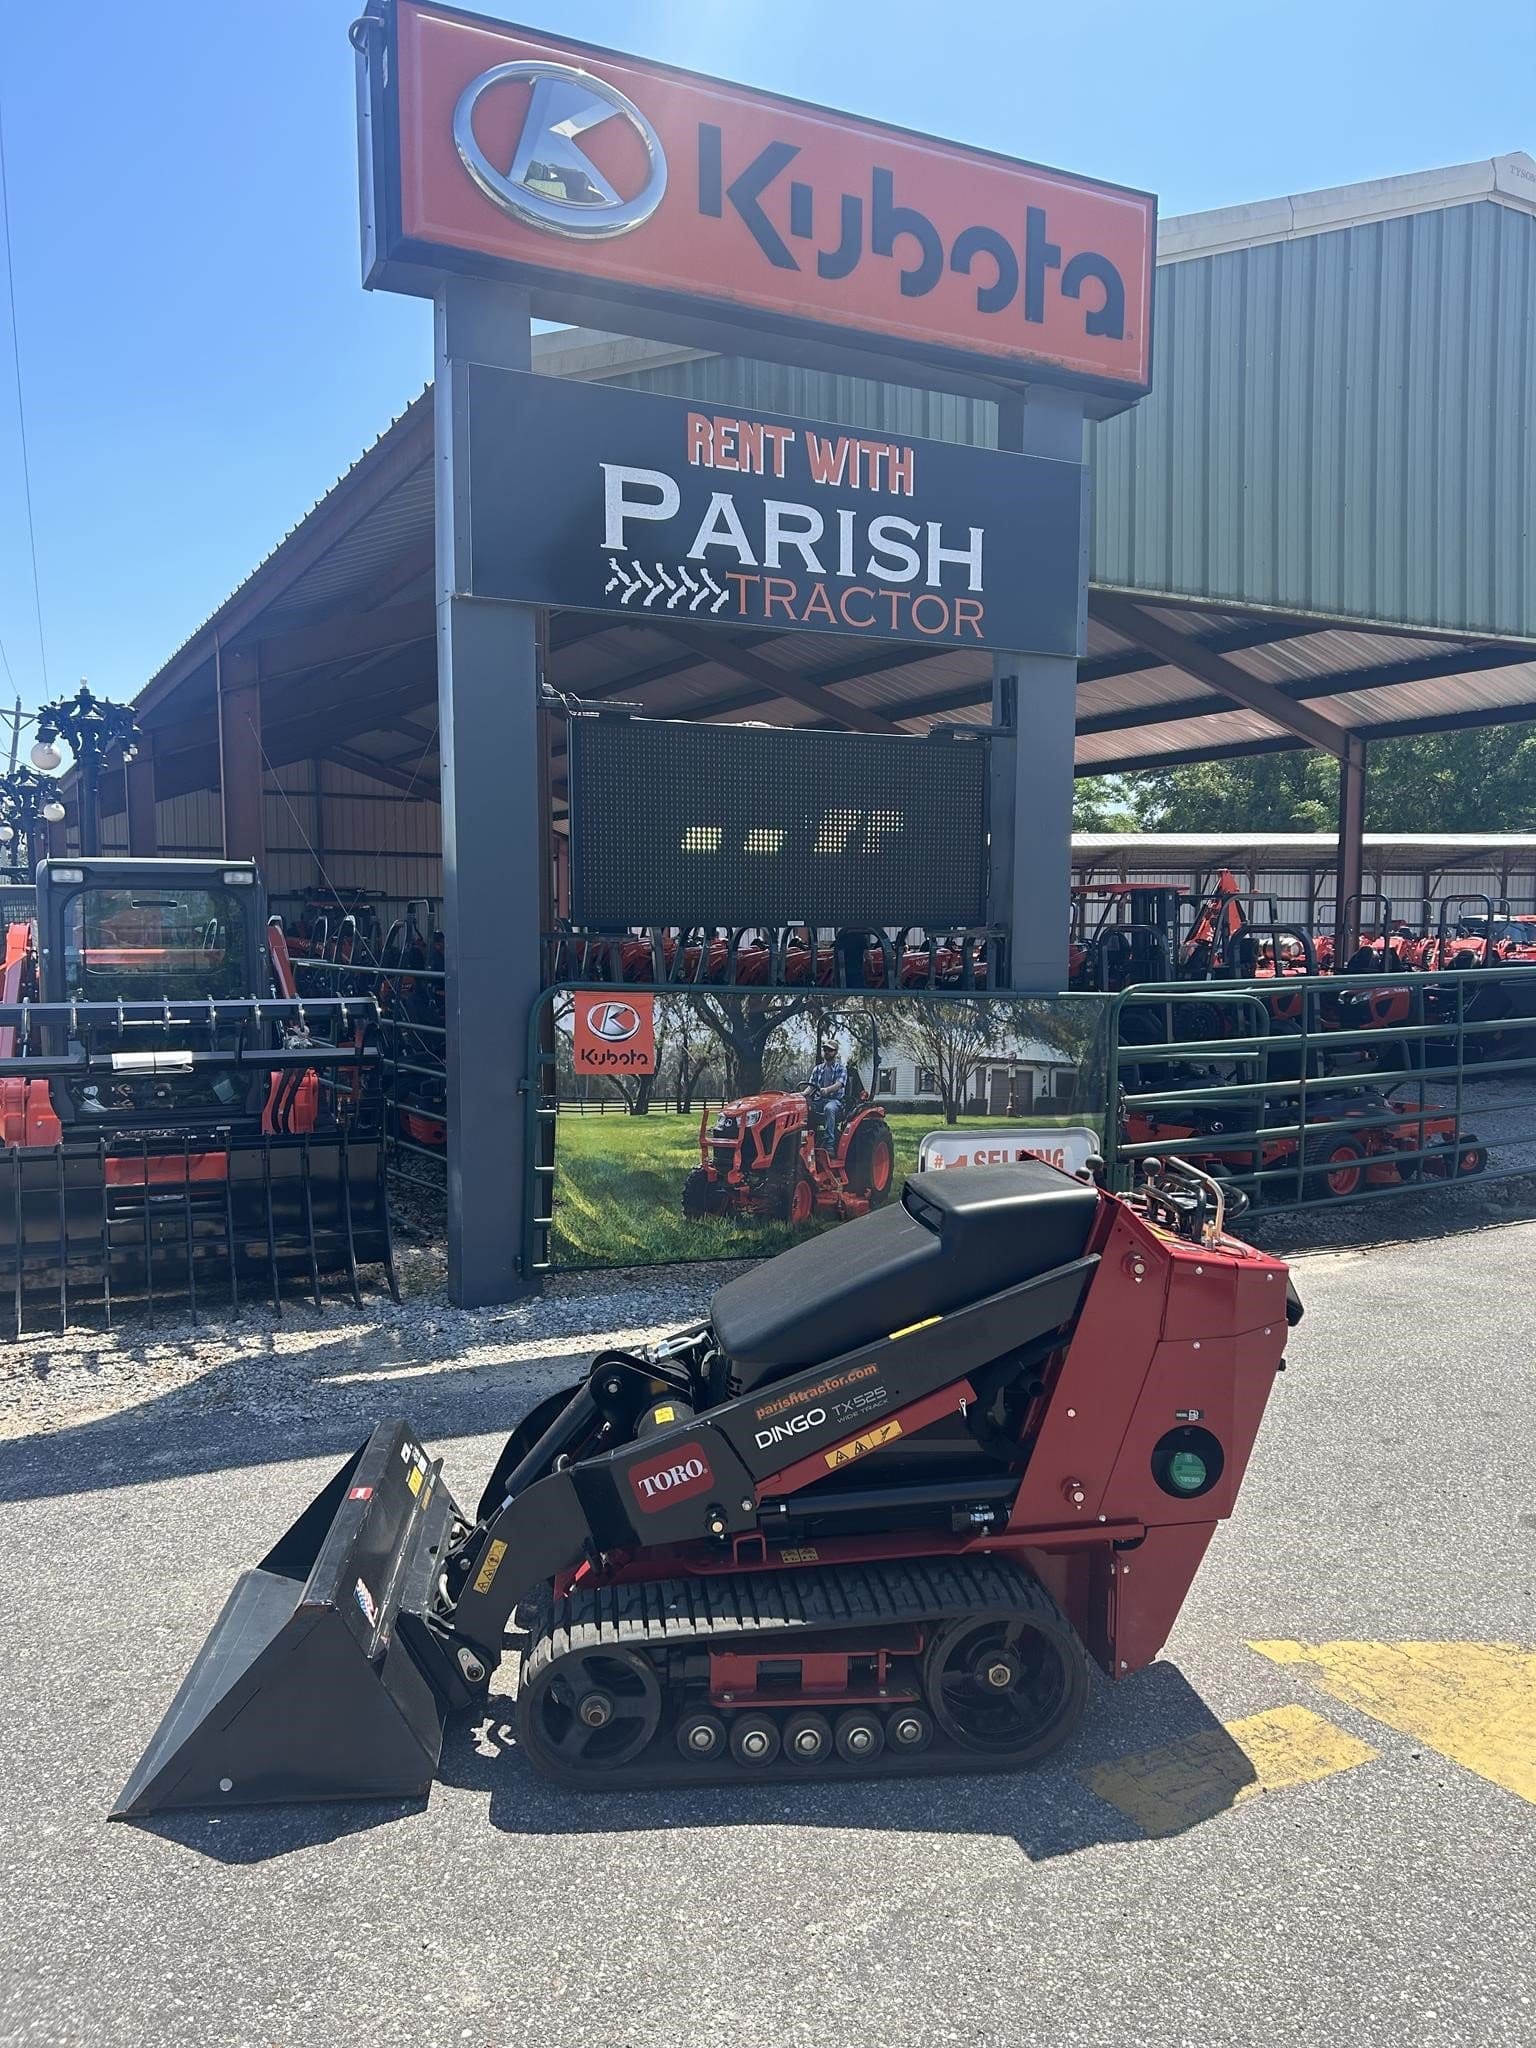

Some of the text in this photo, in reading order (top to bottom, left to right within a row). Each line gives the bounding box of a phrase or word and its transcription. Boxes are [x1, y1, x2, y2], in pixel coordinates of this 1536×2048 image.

[698, 122, 1125, 340] Kubota
[687, 412, 914, 497] RENT WITH
[599, 462, 984, 592] PARISH
[725, 571, 984, 638] TRACTOR
[581, 1048, 649, 1065] Kubota
[755, 1363, 877, 1420] parishtractor.com
[837, 1399, 889, 1424] WIDE TRACK
[754, 1408, 826, 1449] DINGO
[638, 1459, 703, 1497] TORO
